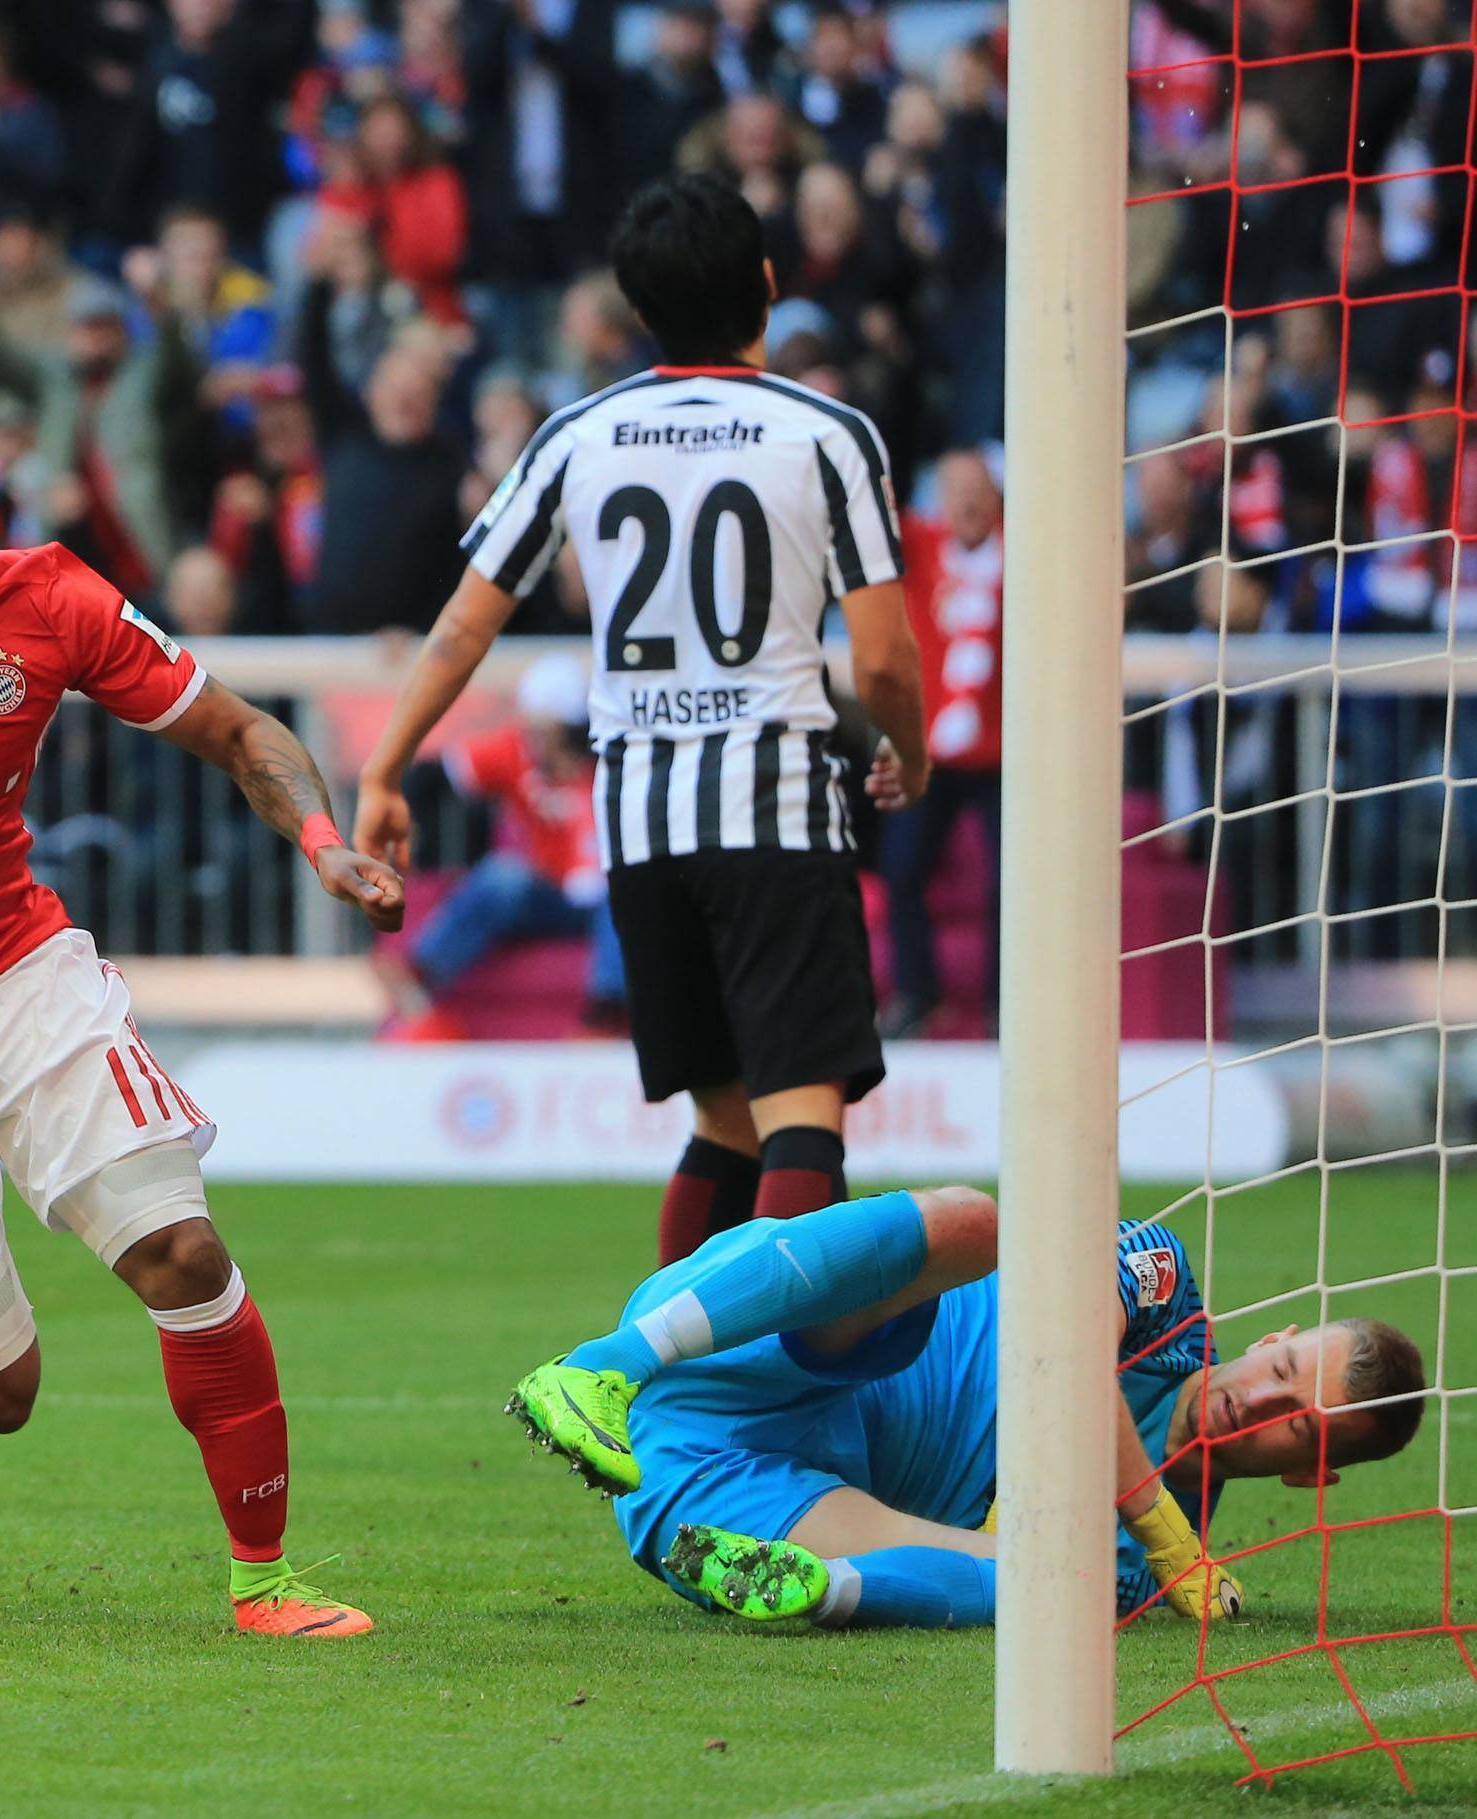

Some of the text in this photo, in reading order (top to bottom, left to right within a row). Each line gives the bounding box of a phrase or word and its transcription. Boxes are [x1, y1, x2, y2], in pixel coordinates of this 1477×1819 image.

[613, 419, 764, 446] Eintracht
[598, 479, 773, 672] 20
[631, 688, 750, 726] HASEBE
[242, 1473, 286, 1504] FCB
